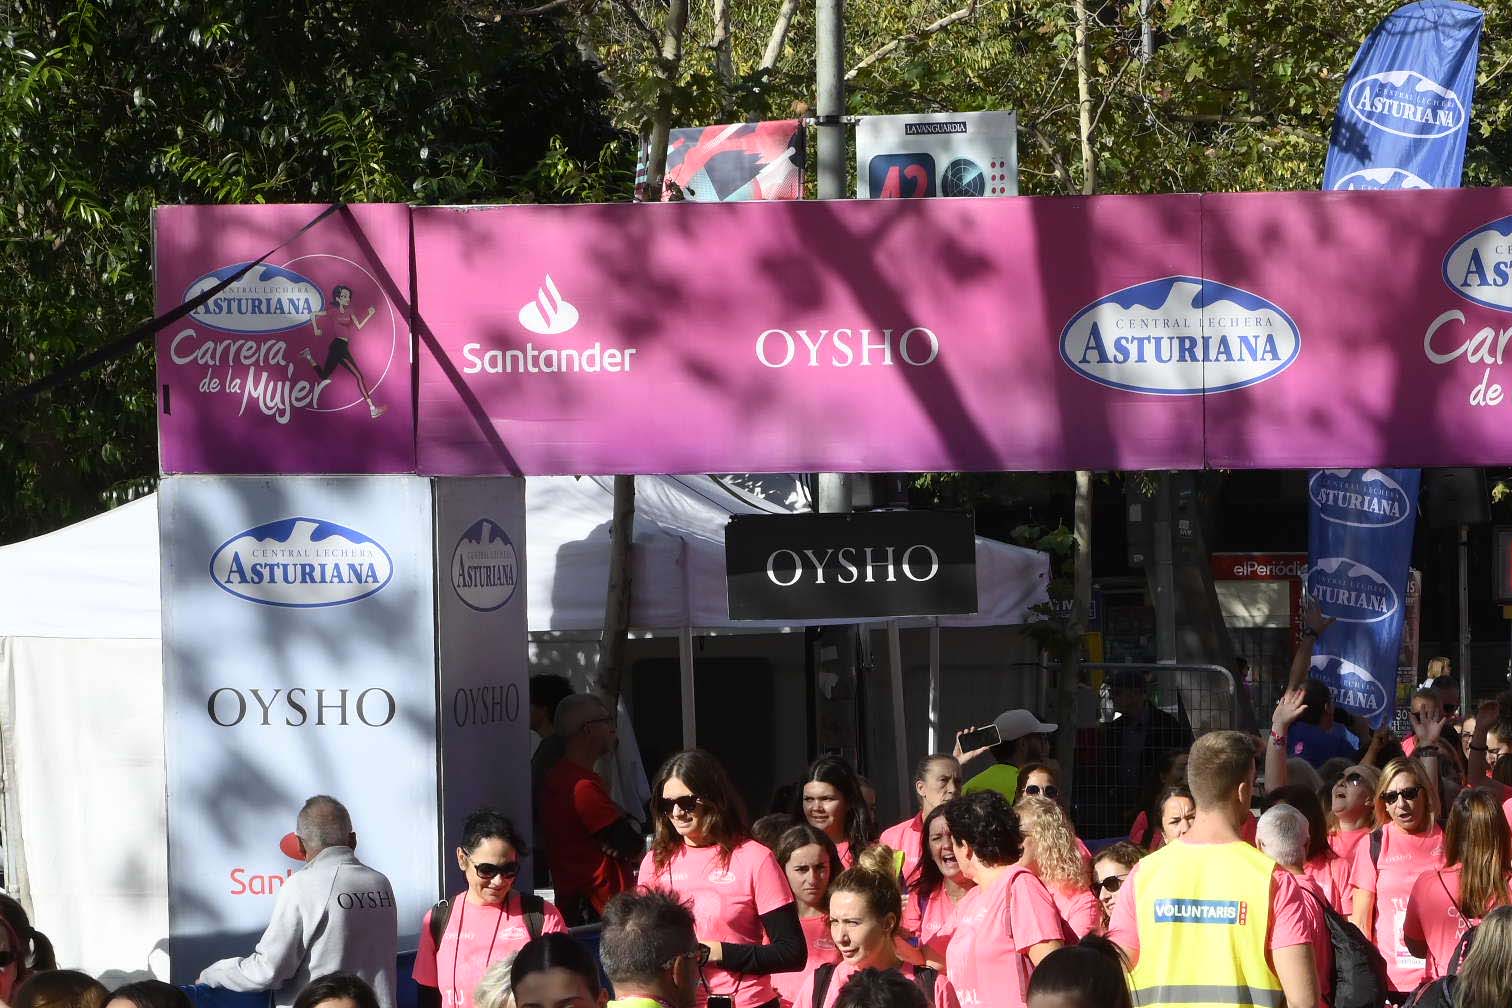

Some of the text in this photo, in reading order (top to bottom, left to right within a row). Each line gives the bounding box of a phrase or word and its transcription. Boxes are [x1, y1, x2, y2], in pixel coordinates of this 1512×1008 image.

[1356, 86, 1454, 128] ASTURIANA
[1078, 320, 1282, 364] ASTURIANA
[1115, 315, 1274, 330] CENTRAL LECHERA
[170, 328, 288, 366] Carrera
[462, 342, 637, 375] Santander
[754, 326, 940, 369] OYSHO
[199, 362, 332, 425] de la Mujer
[1469, 367, 1504, 407] de
[224, 551, 380, 586] ASTURIANA
[251, 548, 375, 559] CENTRAL LECHERA
[766, 543, 940, 588] OYSHO
[456, 559, 514, 590] ASTURIANA
[206, 686, 397, 728] OYSHO
[453, 683, 520, 728] OYSHO
[336, 889, 394, 912] OYSH
[1155, 903, 1238, 921] VOLUNTARIS
